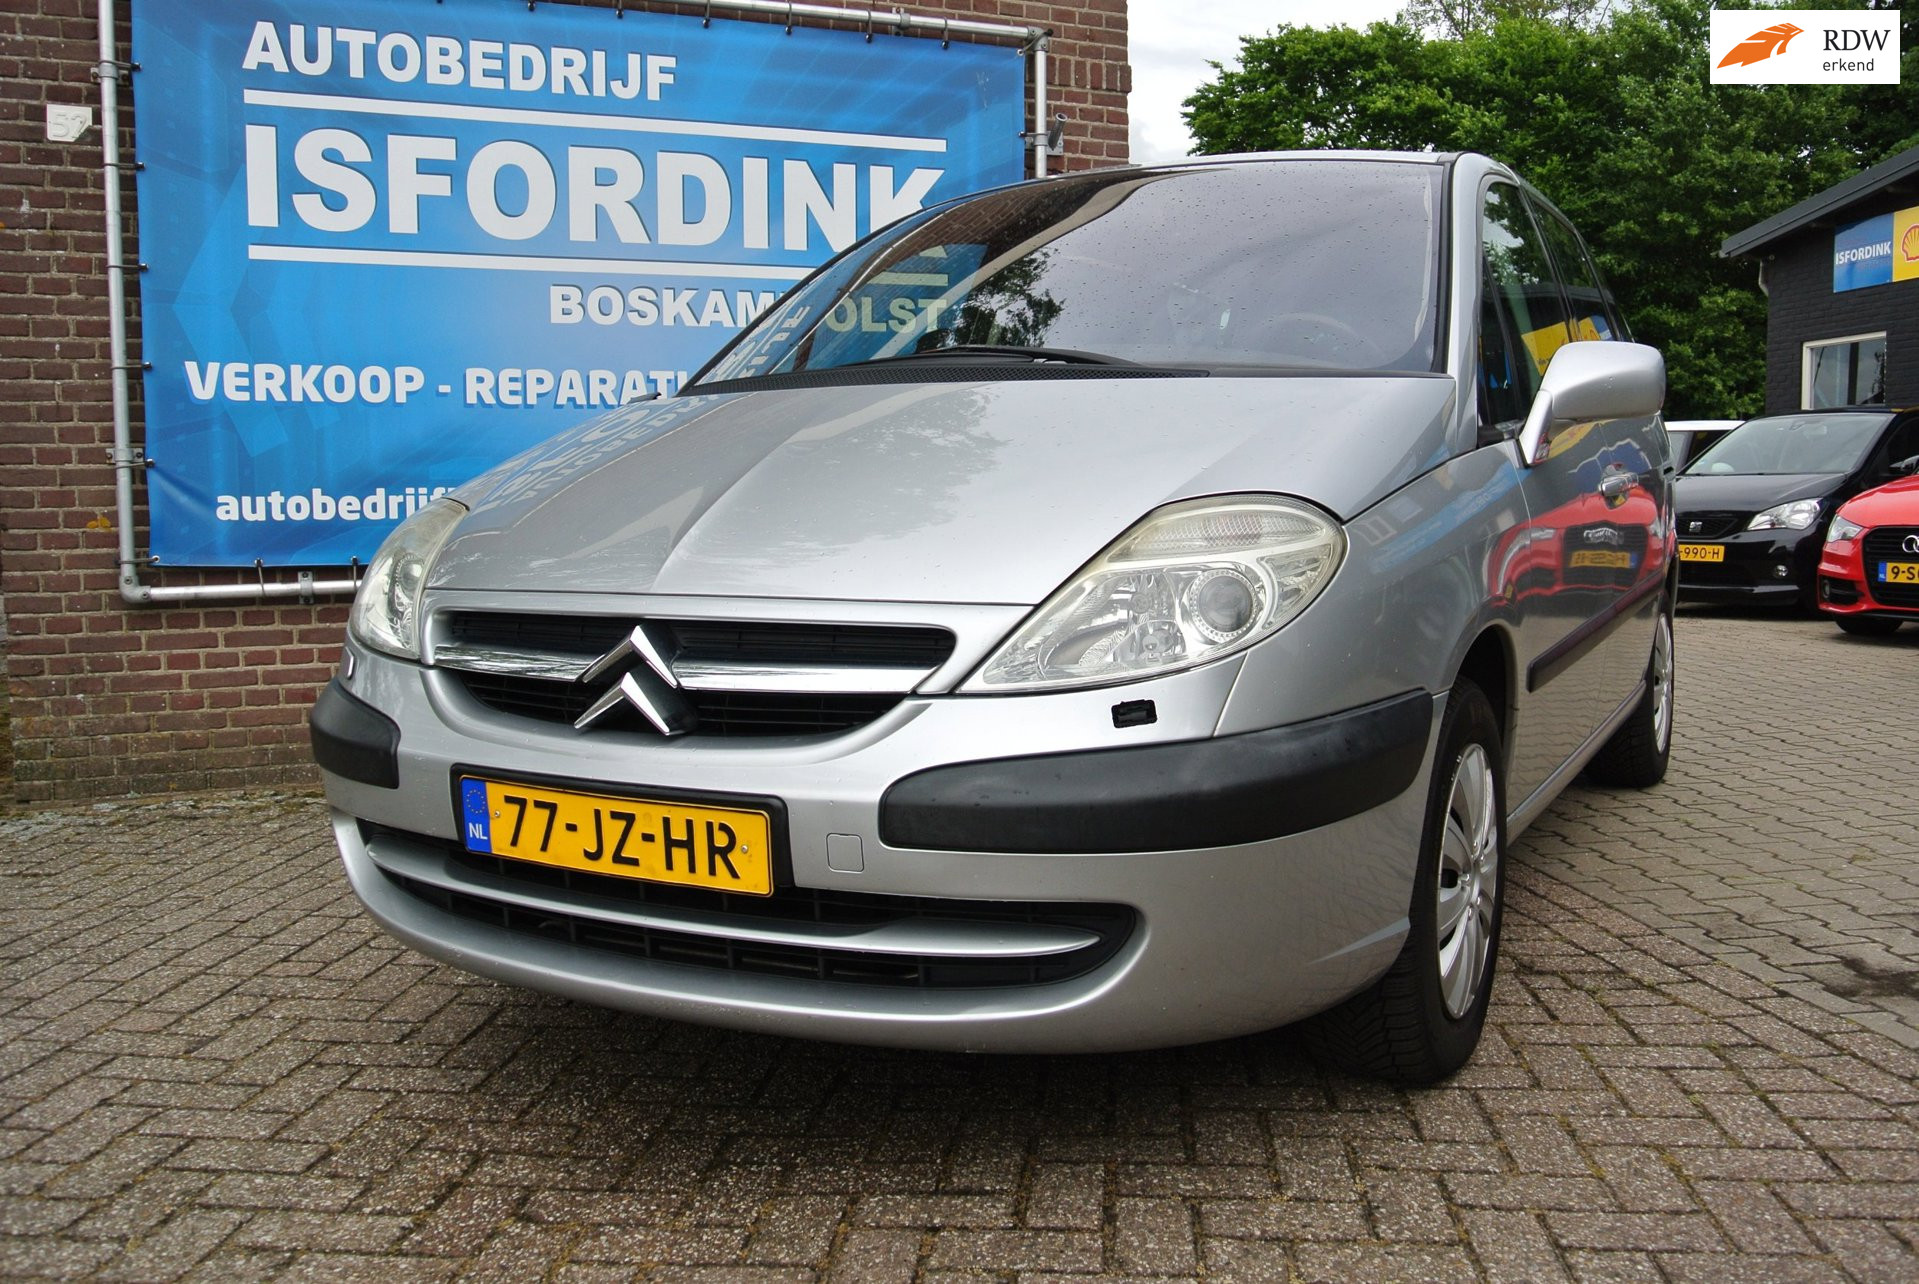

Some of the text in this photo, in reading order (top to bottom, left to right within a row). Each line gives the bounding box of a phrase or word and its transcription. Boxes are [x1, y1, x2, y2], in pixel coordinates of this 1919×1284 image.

[242, 20, 677, 101] AUTOBEDRIJF
[245, 124, 946, 253] ISFORDINK
[1835, 240, 1892, 265] ISFORDINK
[550, 284, 949, 334] BOSKAM OLST
[184, 360, 426, 403] VERKOOP
[1891, 565, 1919, 581] 9-S
[468, 794, 741, 880] NL 77-JZ-HR
